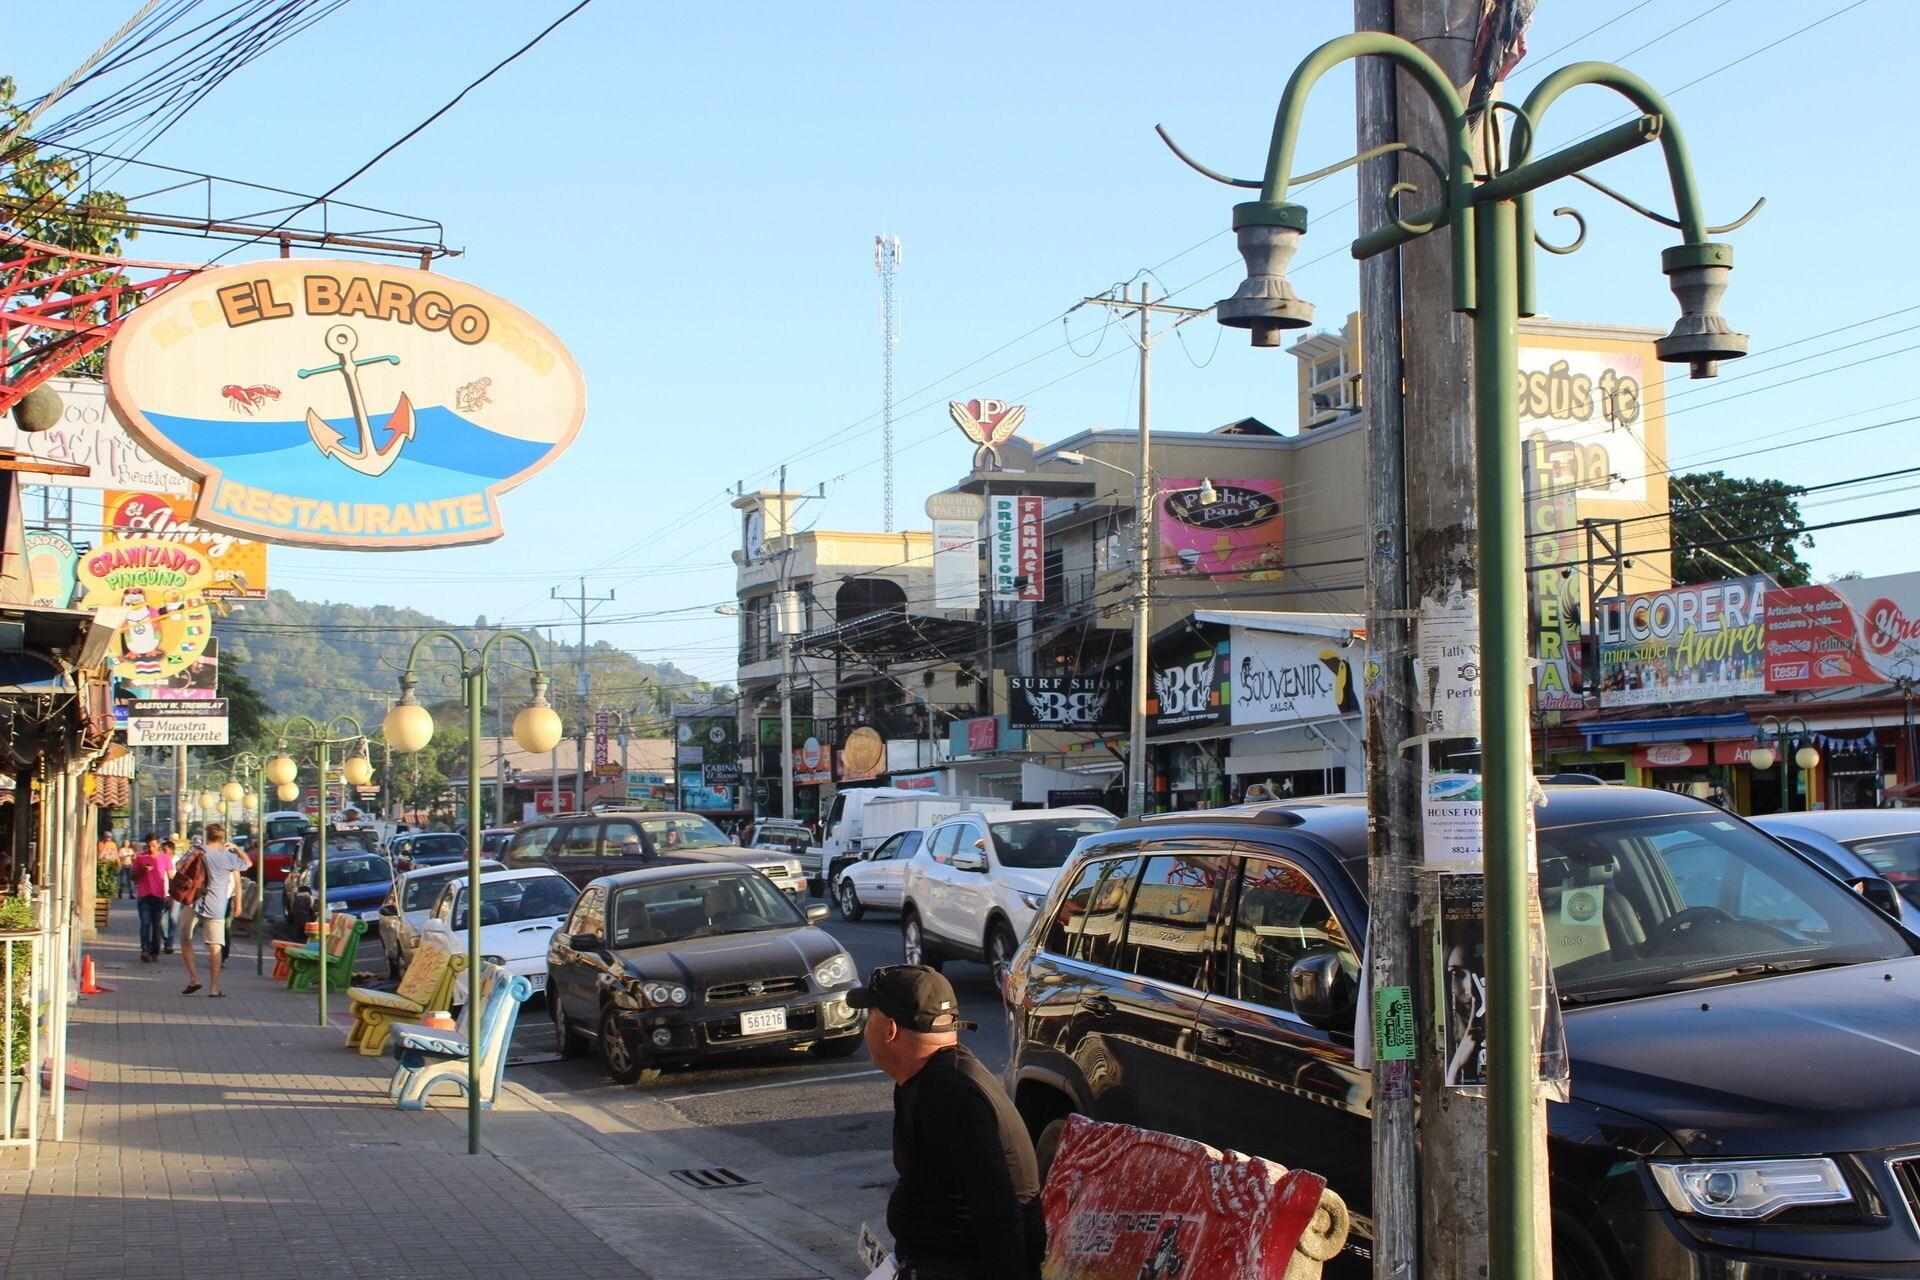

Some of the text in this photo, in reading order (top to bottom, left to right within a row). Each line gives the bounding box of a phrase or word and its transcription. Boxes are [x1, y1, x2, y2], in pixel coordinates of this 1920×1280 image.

[217, 278, 294, 329] EL
[304, 275, 490, 345] BARCO
[1519, 359, 1640, 424] esús te
[217, 482, 491, 537] RESTAURANTE
[1184, 489, 1260, 510] Pchi's
[1204, 507, 1239, 520] Pan
[998, 501, 1012, 595] DRUGSTORE
[1022, 501, 1039, 596] FARMACIA
[88, 546, 201, 578] GRANIZADO
[1534, 441, 1563, 691] LICORERA
[106, 567, 187, 590] PINGÜINO
[1603, 582, 1765, 645] LICORERA
[1769, 619, 1807, 631] escolares
[1604, 645, 1671, 664] mini super
[1773, 666, 1798, 678] tesa
[1012, 678, 1124, 690] SURF SHOP
[1241, 664, 1329, 702] SOUVENIR
[135, 702, 168, 710] GASTON
[1269, 701, 1295, 712] SALSA
[141, 729, 222, 741] Permanente
[156, 720, 206, 731] Muestra
[705, 764, 742, 772] CABINAS
[1428, 808, 1461, 816] HOUSE
[747, 1013, 782, 1028] 561216
[1387, 1025, 1395, 1046] Chico
